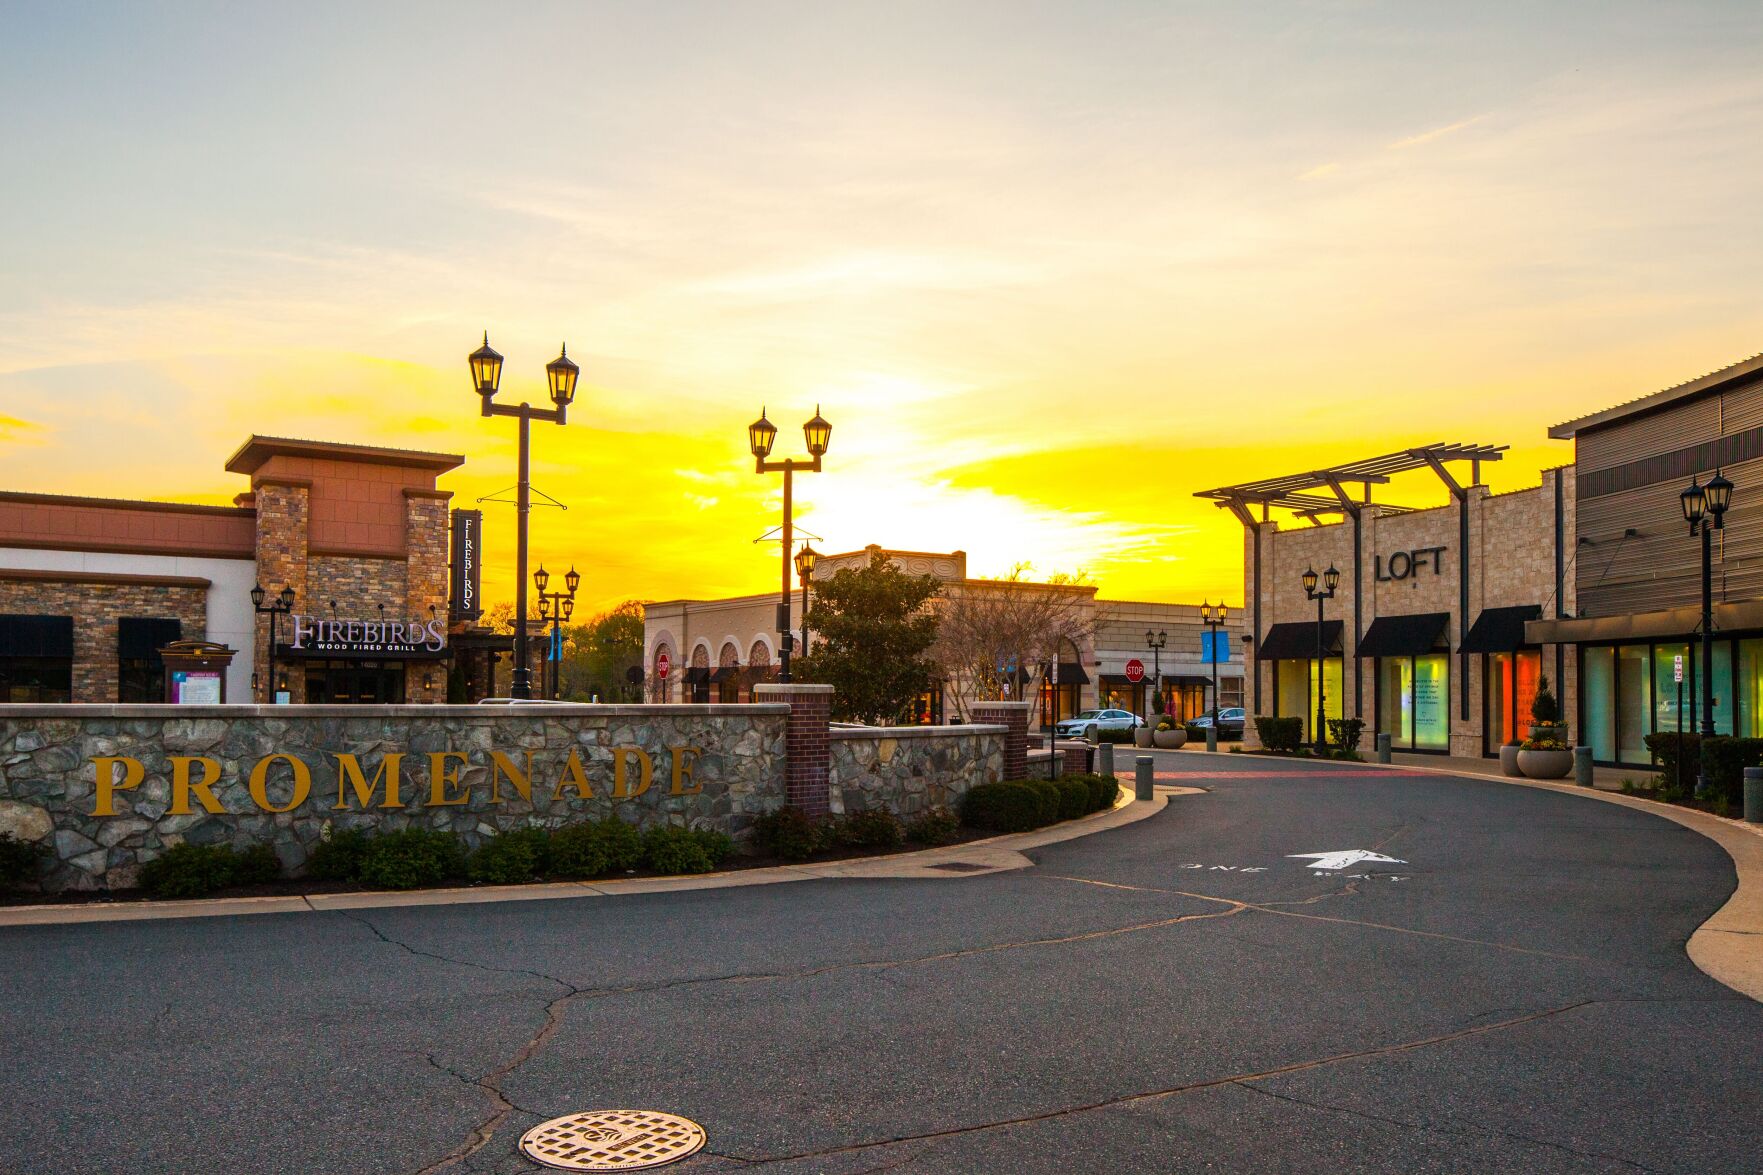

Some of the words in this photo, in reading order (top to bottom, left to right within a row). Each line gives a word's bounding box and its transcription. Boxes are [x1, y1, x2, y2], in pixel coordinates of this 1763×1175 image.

[463, 519, 473, 609] FIREBIRDS
[1376, 546, 1447, 581] LOFT
[290, 614, 444, 652] FIREBIRDS
[1127, 666, 1143, 675] STOP
[88, 746, 703, 818] PROMENADE
